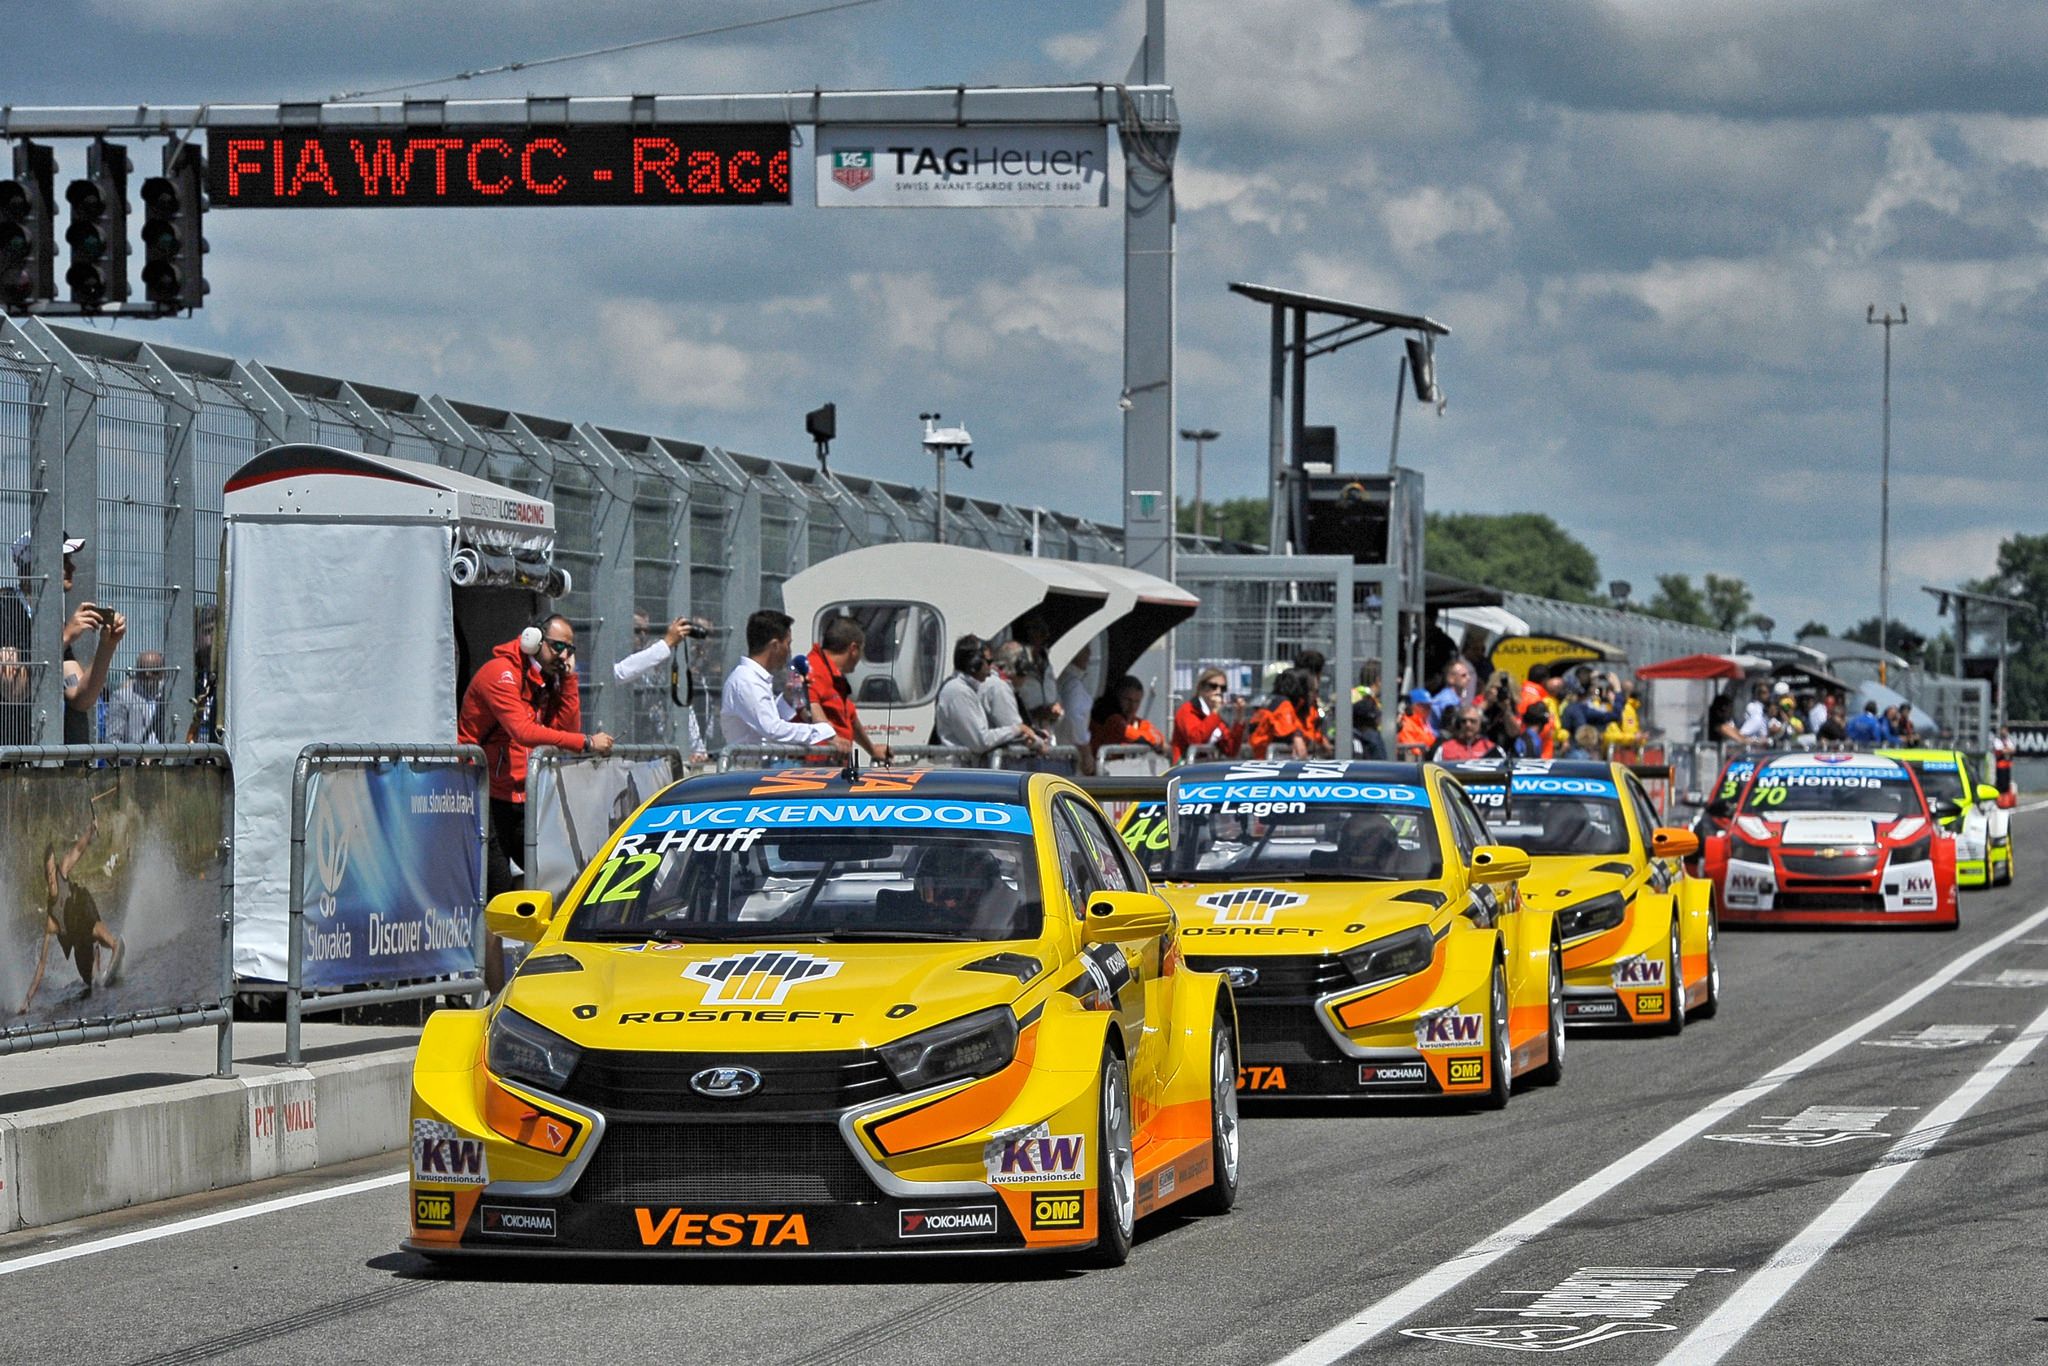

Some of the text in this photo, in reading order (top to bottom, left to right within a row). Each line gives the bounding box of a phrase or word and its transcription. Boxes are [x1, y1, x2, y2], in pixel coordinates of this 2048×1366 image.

[228, 139, 338, 196] FIA
[350, 138, 567, 195] WTCC
[633, 137, 788, 194] Race
[896, 181, 1082, 191] SWISS AVANT-GARDE SINCE 1860
[1721, 781, 1738, 799] 3
[1751, 787, 1787, 807] 70
[1177, 803, 1213, 816] an
[1220, 801, 1306, 818] Lagen
[583, 853, 662, 906] 12
[1907, 877, 1932, 891] KW
[307, 923, 351, 961] Slovakia
[368, 912, 421, 957] Discover
[1620, 961, 1664, 983] KW
[1638, 998, 1663, 1010] OMP
[1425, 1017, 1483, 1042] KW
[1375, 1069, 1424, 1080] YOKOHAMA
[1451, 1064, 1481, 1079] OMP
[255, 1100, 315, 1138] PIT WALL
[422, 1138, 484, 1176] KW
[1000, 1136, 1084, 1174] KW
[416, 1173, 487, 1185] kwsuspensions.de
[991, 1172, 1082, 1184] kwsuspensions.de
[417, 1201, 452, 1220] OMP
[1035, 1200, 1081, 1220] OMP
[500, 1213, 553, 1230] YOKOHAMA
[634, 1207, 810, 1247] VESTA
[924, 1213, 993, 1229] YOKOHAMA
